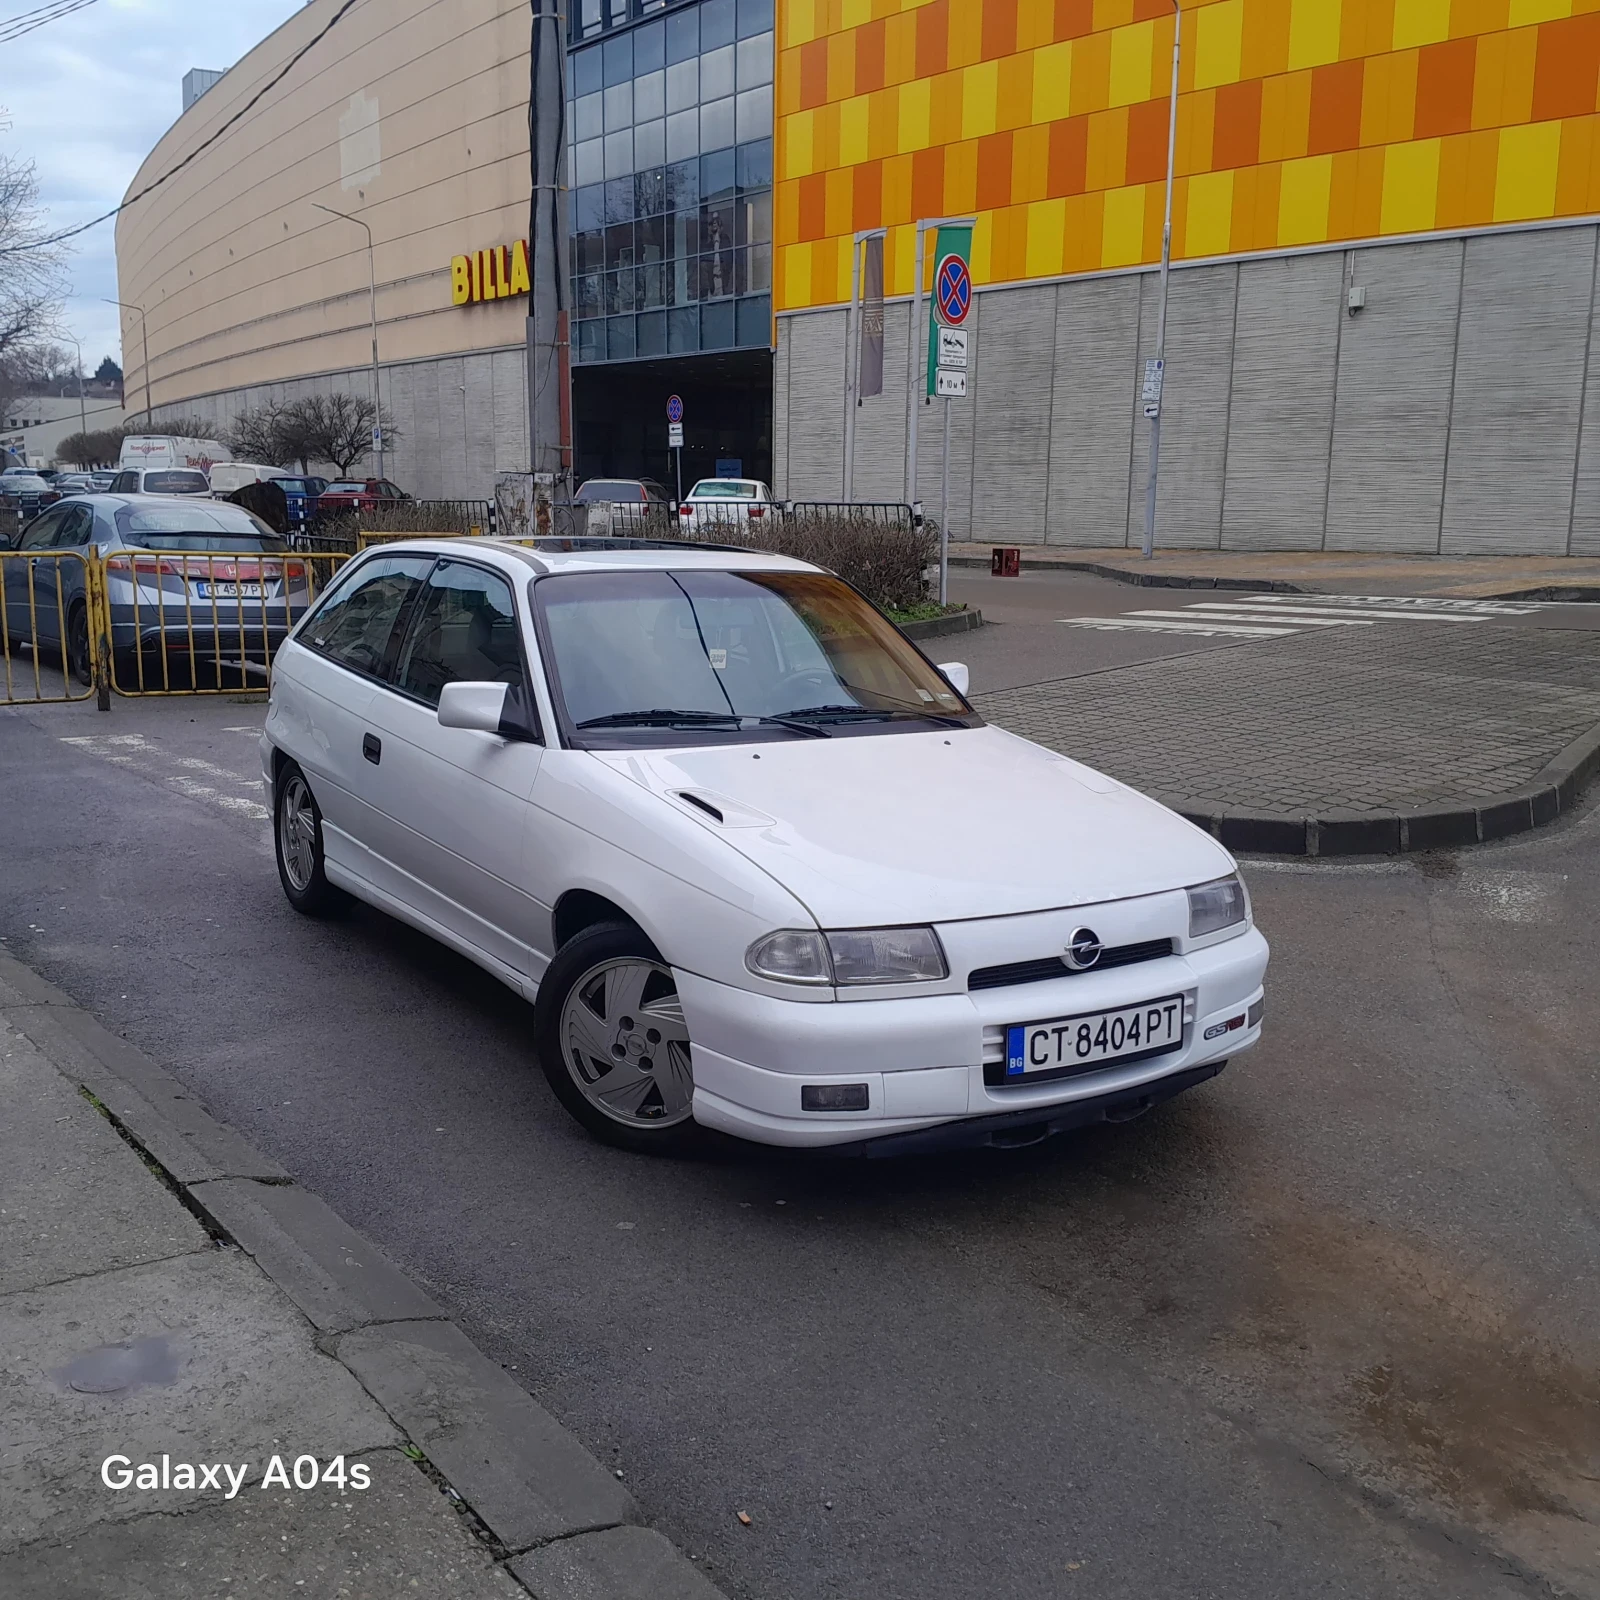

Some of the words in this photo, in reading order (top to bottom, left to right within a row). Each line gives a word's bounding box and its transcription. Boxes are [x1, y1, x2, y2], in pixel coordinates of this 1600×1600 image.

[451, 239, 531, 306] BILLA
[946, 379, 953, 389] 10
[1030, 1026, 1069, 1066] CT
[1076, 1013, 1141, 1058] 8404
[1146, 1004, 1178, 1044] PT
[1010, 1056, 1023, 1069] BG
